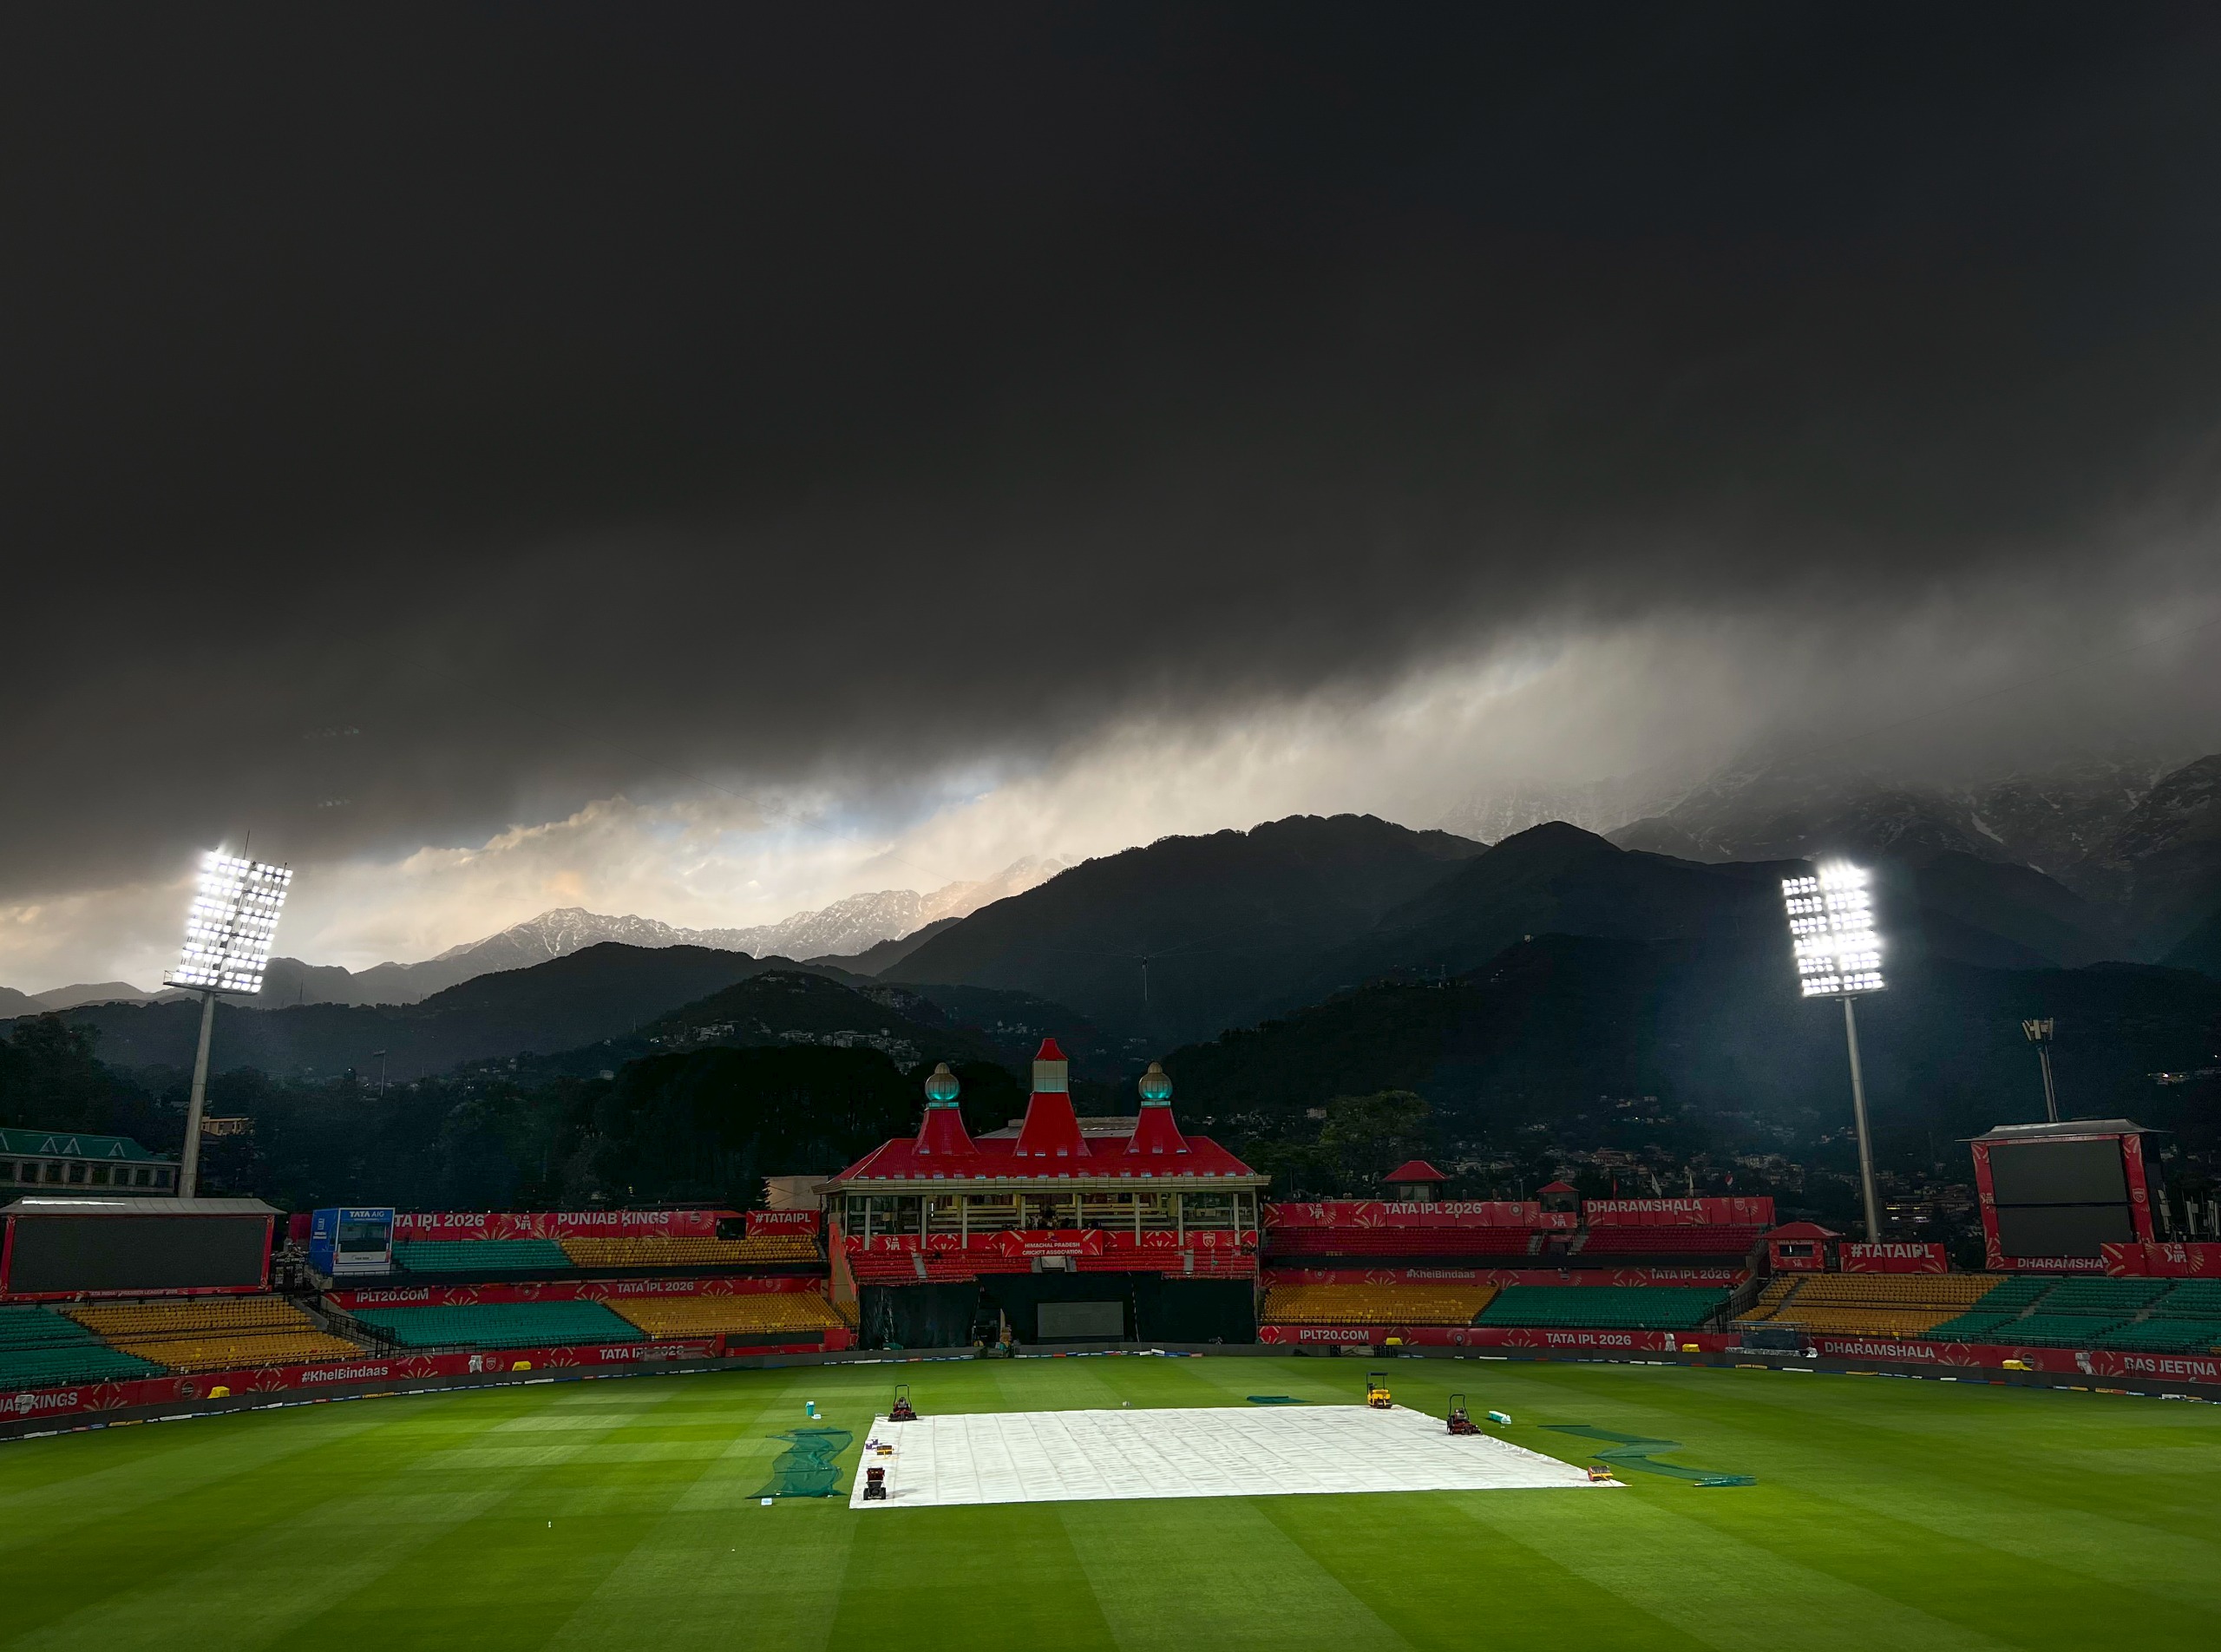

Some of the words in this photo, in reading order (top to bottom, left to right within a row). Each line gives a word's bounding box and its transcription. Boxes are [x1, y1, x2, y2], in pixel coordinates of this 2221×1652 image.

[1383, 1203, 1419, 1214] TATA
[1421, 1203, 1442, 1214] IPL
[1445, 1203, 1482, 1214] 2026
[1588, 1200, 1702, 1213] DHARAMSHALA
[395, 1215, 413, 1227] TA
[417, 1215, 441, 1228] IPL
[444, 1215, 485, 1227] 2026
[558, 1213, 618, 1225] PUNJAB
[621, 1213, 669, 1225] KINGS
[755, 1213, 811, 1223] #TATAIPL
[1851, 1243, 1934, 1258] #TATAIPL
[1406, 1269, 1475, 1279] #KhelBindaas
[1651, 1269, 1678, 1280] TATA
[1680, 1269, 1698, 1280] IPL
[1700, 1269, 1731, 1280] 2026
[617, 1283, 643, 1293] TATA
[646, 1282, 664, 1292] IPL
[665, 1282, 694, 1291] 2026
[357, 1289, 429, 1302] IPLT20.COM
[1300, 1329, 1369, 1341] IPLT20.COM
[1546, 1333, 1576, 1344] TATA
[1578, 1334, 1596, 1345] IPL
[1599, 1334, 1631, 1345] 2026
[599, 1348, 629, 1360] TATA
[1825, 1341, 1935, 1359] DHARAMSHALA
[2159, 1360, 2218, 1376] JEETNA
[301, 1366, 389, 1383] #KhelBindaas
